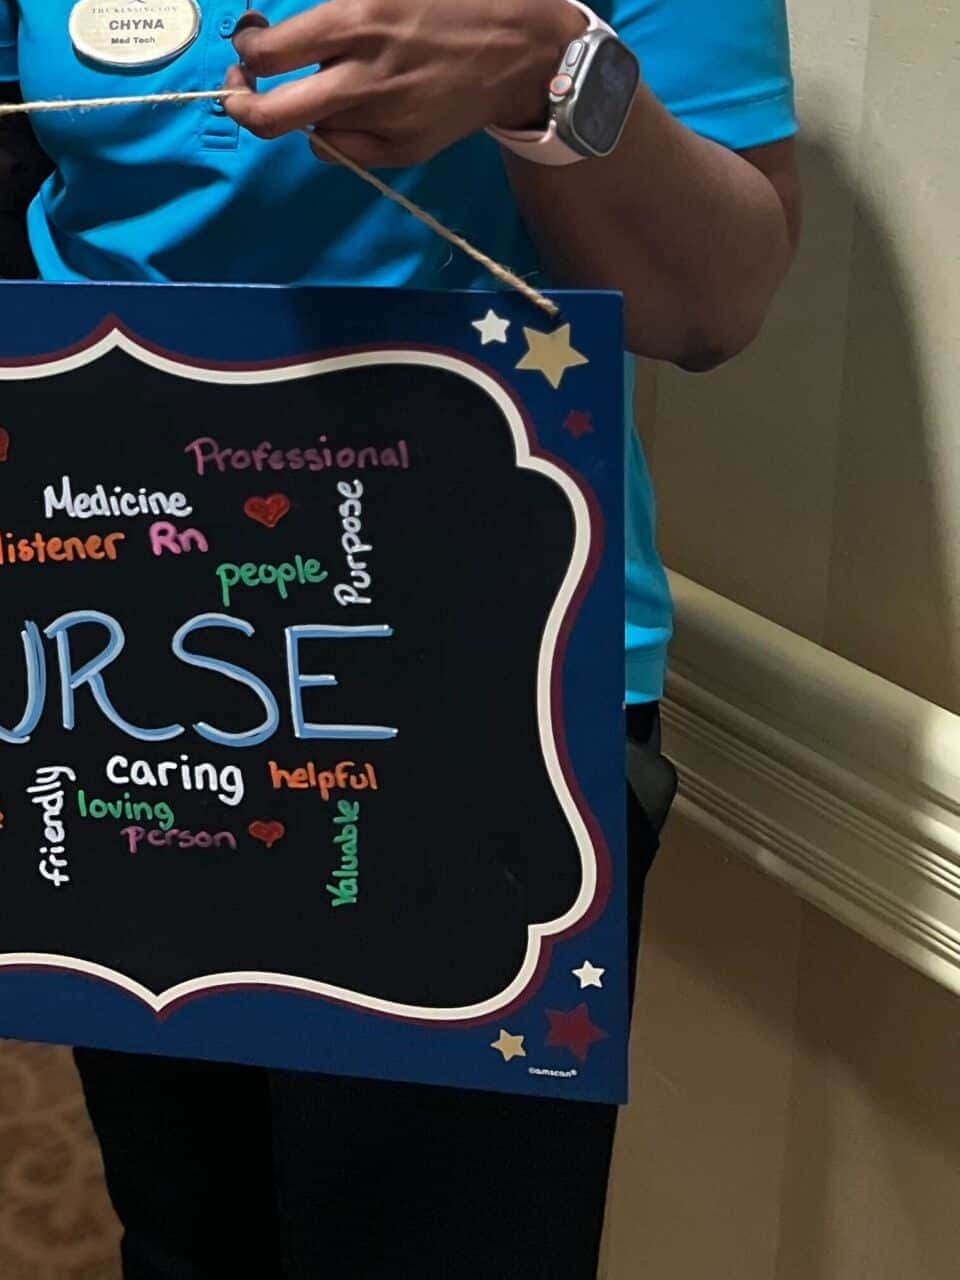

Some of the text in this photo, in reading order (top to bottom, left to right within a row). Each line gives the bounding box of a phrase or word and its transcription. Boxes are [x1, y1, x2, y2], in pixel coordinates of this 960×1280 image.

[109, 19, 165, 31] CHYNA
[132, 36, 156, 44] Tech
[184, 435, 409, 476] Professional
[43, 475, 192, 519] Medicine
[149, 521, 209, 555] Rn
[334, 479, 373, 607] Purpose
[216, 554, 329, 607] people
[106, 754, 245, 807] caring
[268, 760, 378, 801] helpful
[26, 766, 77, 887] friendly
[77, 789, 175, 831] loving
[326, 799, 360, 907] Valuable
